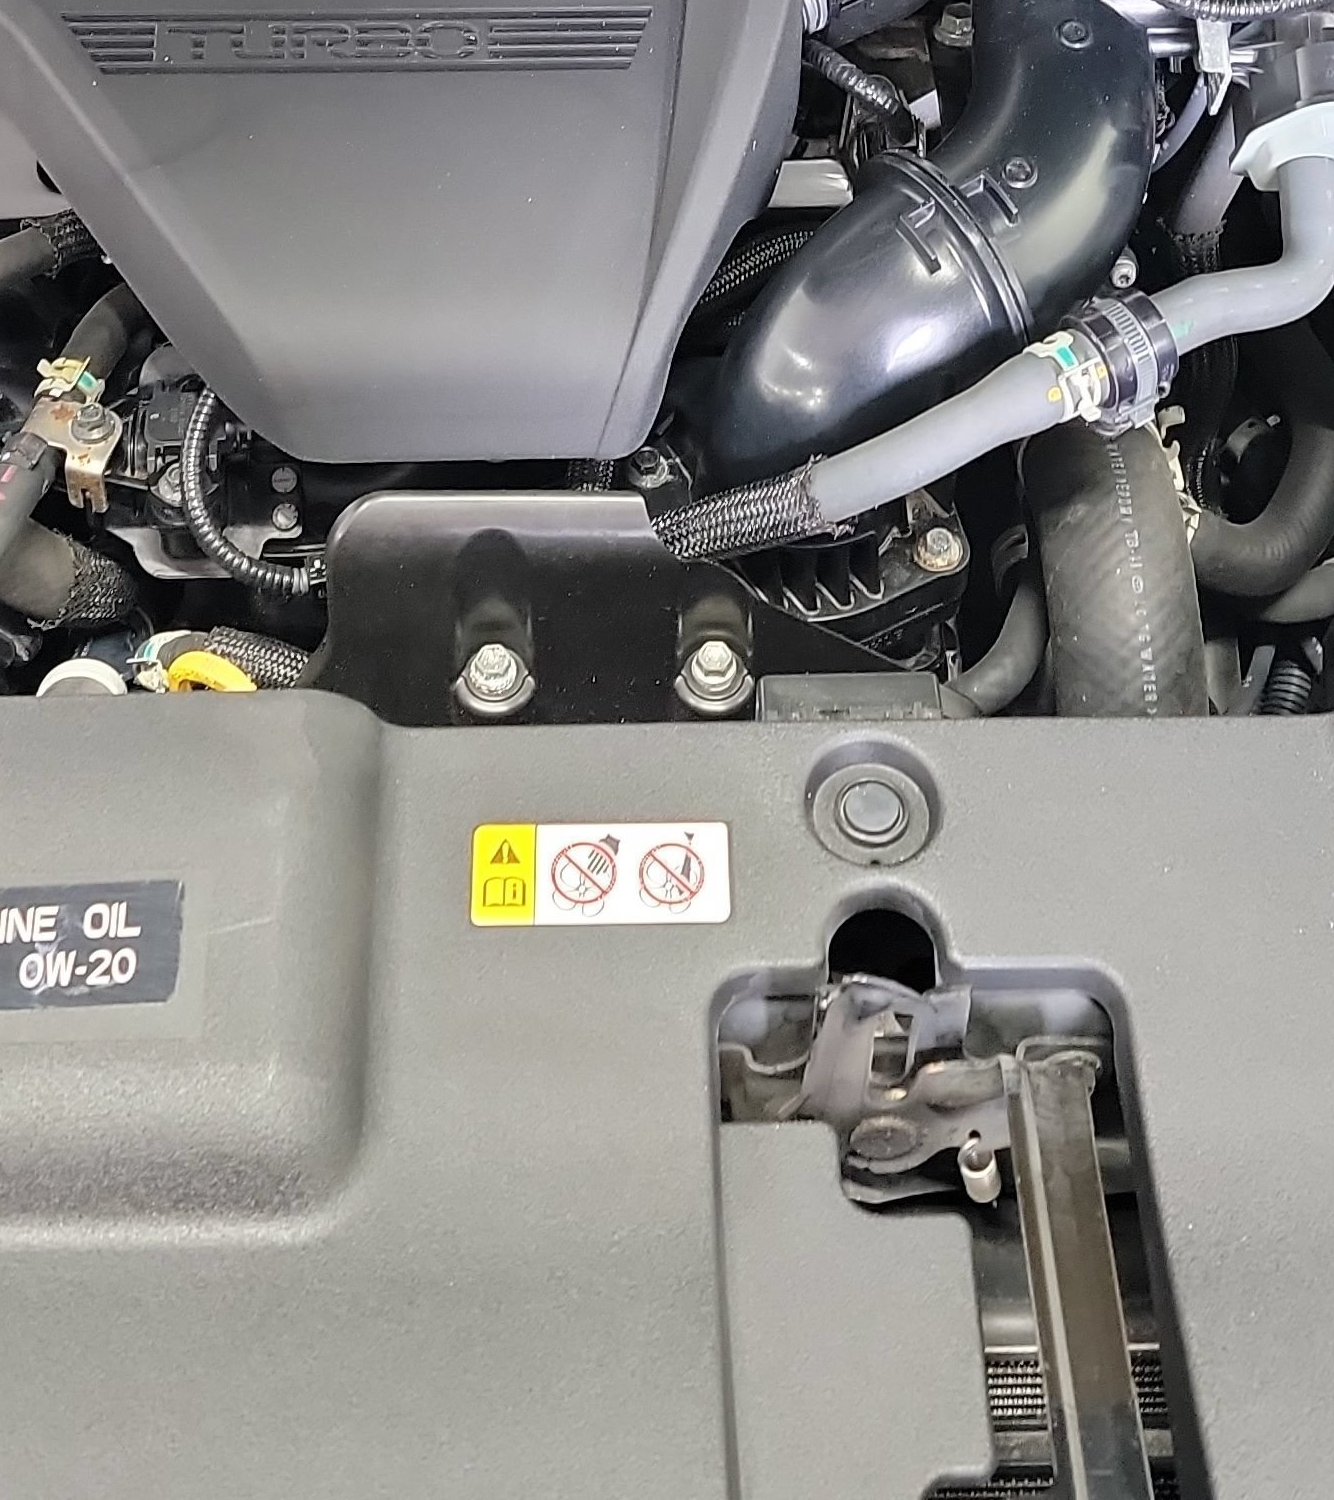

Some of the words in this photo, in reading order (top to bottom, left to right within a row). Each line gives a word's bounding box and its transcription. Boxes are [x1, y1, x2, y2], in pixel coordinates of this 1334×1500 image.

[167, 20, 479, 61] TURBO
[82, 901, 142, 939] OIL
[19, 947, 137, 989] 0W-20
